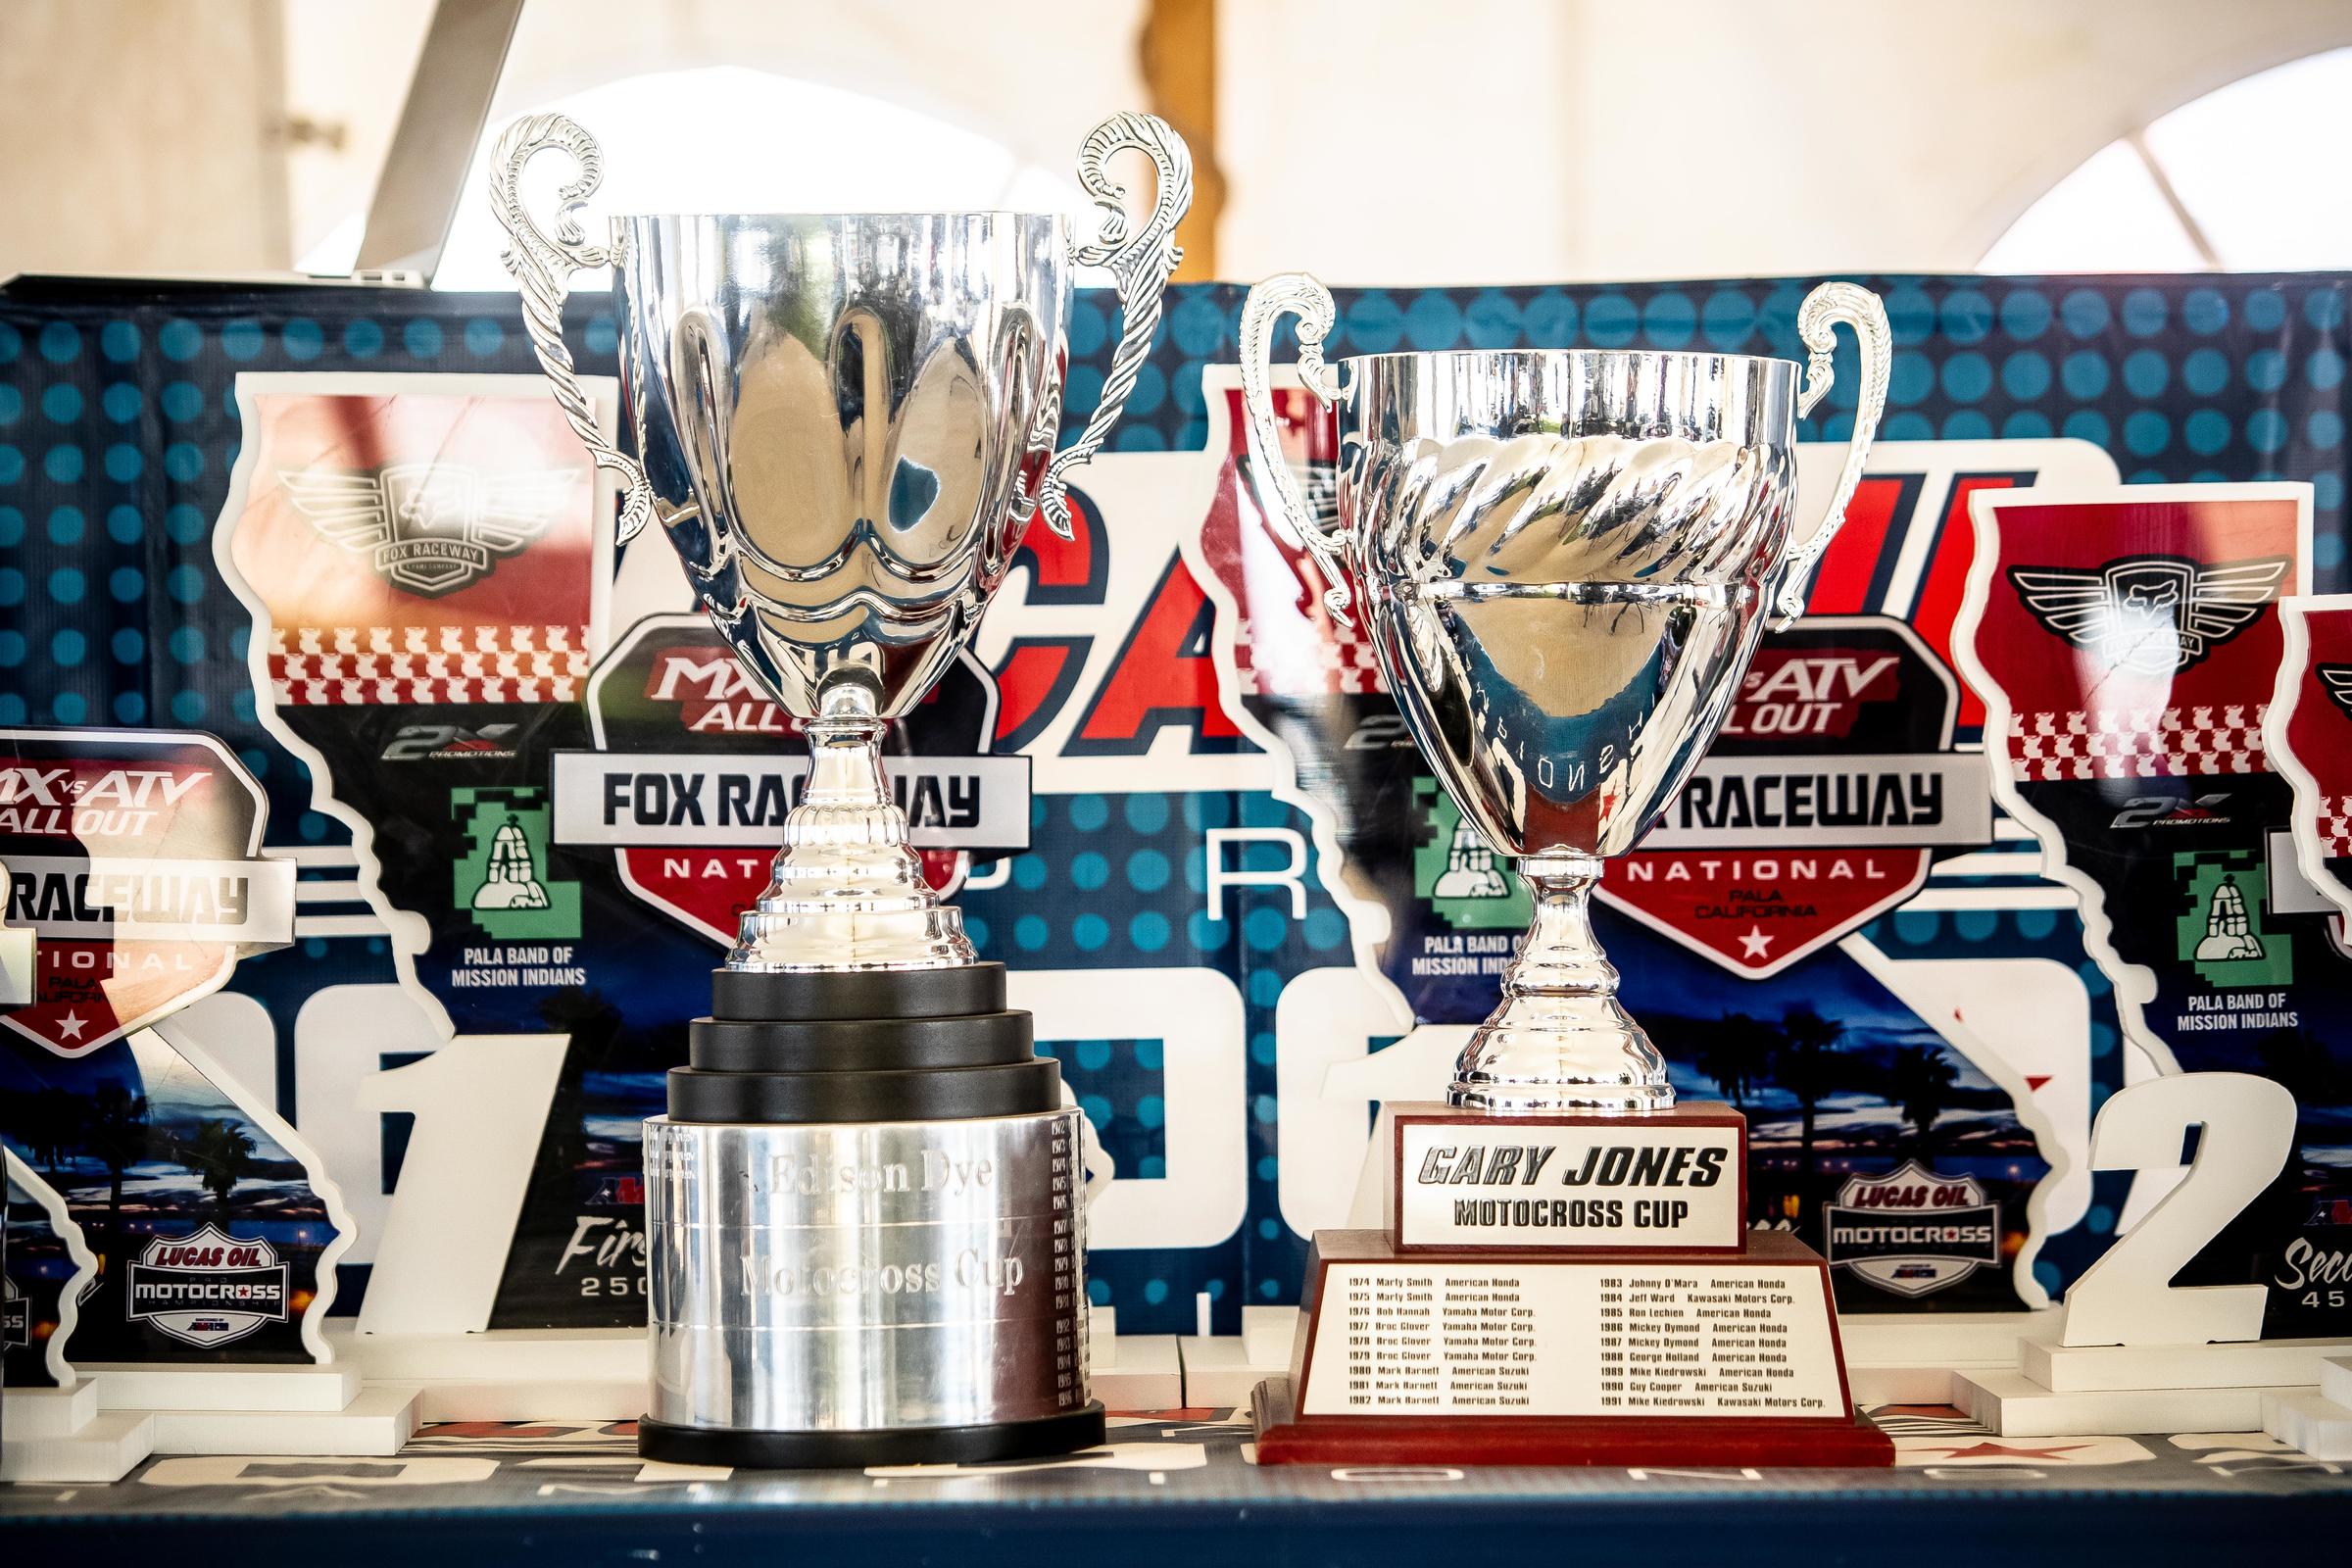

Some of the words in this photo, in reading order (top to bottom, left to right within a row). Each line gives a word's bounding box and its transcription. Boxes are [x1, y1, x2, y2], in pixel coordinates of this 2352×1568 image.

[383, 545, 408, 564] FOX
[413, 542, 478, 562] RACEWAY
[1746, 657, 1899, 702] ATV
[689, 703, 783, 731] ALL
[1751, 704, 1841, 734] OUT
[71, 770, 213, 808] ATV
[604, 772, 705, 826] FOX
[717, 772, 980, 827] RAAY
[1681, 772, 1943, 829] RACEWAY
[73, 809, 160, 836] OUT
[1627, 858, 1886, 882] NATIONAL
[4, 871, 248, 925] RACEWAY
[1729, 889, 1784, 903] PALA
[1695, 905, 1817, 920] CALIFORNIA
[1424, 936, 1463, 954] PALA
[1467, 935, 1508, 954] BAND
[464, 948, 504, 965] PALA
[507, 947, 548, 964] BAND
[552, 946, 573, 964] OF
[1412, 956, 1479, 975] MISSION
[452, 968, 518, 987] MISSION
[522, 967, 586, 986] INDIANS
[2187, 995, 2224, 1011] PALA
[2227, 994, 2264, 1010] BAND
[2268, 993, 2286, 1008] OF
[2178, 1013, 2237, 1031] MISSION
[2241, 1011, 2299, 1029] INDIANS
[770, 1151, 909, 1195] Edison
[920, 1149, 994, 1196] Dye
[1418, 1145, 1557, 1186] GARY
[1561, 1146, 1729, 1188] JONES
[359, 1033, 571, 1334] 1
[1853, 1185, 1929, 1207] LUCAS
[1932, 1185, 1971, 1206] OIL
[1454, 1198, 1623, 1228] MOTOCROSS
[1633, 1199, 1689, 1229] CUP
[2059, 1071, 2298, 1348] 2
[1834, 1226, 1992, 1245] MOTOCROSS
[155, 1247, 224, 1267] LUCAS
[226, 1247, 262, 1267] OIL
[740, 1253, 943, 1298] Motocross
[956, 1248, 1024, 1297] Cup
[134, 1284, 281, 1300] MOTOCROSS
[1348, 1277, 1370, 1287] 1974
[1375, 1277, 1403, 1289] Marty
[1405, 1277, 1433, 1287] Smith
[1444, 1277, 1490, 1288] American
[1491, 1278, 1520, 1288] Honda
[1598, 1278, 1623, 1289] 1983
[1627, 1278, 1662, 1291] Johnny
[1663, 1278, 1698, 1289] O'Mara
[1709, 1278, 1755, 1290] American
[1756, 1278, 1786, 1290] Honda
[1348, 1292, 1370, 1301] 1975
[1375, 1292, 1403, 1303] Marty
[1405, 1292, 1433, 1301] Smith
[1444, 1292, 1490, 1302] American
[1491, 1293, 1520, 1302] Honda
[1598, 1293, 1623, 1303] 1984
[1627, 1293, 1647, 1303] Jeff
[1648, 1293, 1676, 1304] Ward
[1686, 1293, 1732, 1304] Kawasaki
[1733, 1293, 1768, 1304] Motors
[1769, 1294, 1795, 1306] Corp.
[1348, 1306, 1370, 1316] 1976
[1375, 1306, 1394, 1316] Bob
[1395, 1306, 1431, 1316] Hannah
[1441, 1306, 1478, 1317] Yamaha
[1479, 1306, 1508, 1317] Motor
[1509, 1306, 1536, 1319] Corp.
[1599, 1307, 1623, 1318] 1985
[1628, 1307, 1646, 1318] Ron
[1647, 1307, 1685, 1319] Lechien
[1694, 1307, 1740, 1318] American
[1741, 1307, 1772, 1319] Honda
[1348, 1321, 1369, 1332] 1977
[1374, 1321, 1397, 1331] Broc
[1398, 1321, 1431, 1331] Glover
[1441, 1321, 1478, 1332] Yamaha
[1479, 1321, 1508, 1332] Motor
[1509, 1321, 1536, 1334] Corp.
[1599, 1322, 1624, 1333] 1986
[1628, 1322, 1662, 1334] Mickey
[1663, 1322, 1700, 1335] Dymond
[1711, 1322, 1757, 1334] American
[1758, 1322, 1788, 1334] Honda
[1348, 1336, 1371, 1347] 1978
[1375, 1336, 1398, 1346] Broc
[1400, 1336, 1432, 1347] Glover
[1442, 1336, 1479, 1347] Yamaha
[1480, 1336, 1509, 1347] Motor
[1510, 1336, 1537, 1348] Corp.
[1599, 1337, 1622, 1348] 1987
[1627, 1337, 1661, 1349] Mickey
[1662, 1337, 1699, 1349] Dymond
[1710, 1337, 1756, 1348] American
[1757, 1337, 1788, 1348] Honda
[1348, 1350, 1371, 1361] 1979
[1375, 1350, 1398, 1360] Broc
[1400, 1350, 1432, 1361] Glover
[1443, 1351, 1479, 1361] Yamaha
[1480, 1350, 1509, 1361] Motor
[1511, 1351, 1538, 1363] Corp.
[1599, 1351, 1624, 1362] 1988
[1628, 1351, 1663, 1364] George
[1664, 1351, 1700, 1363] Holland
[1710, 1351, 1756, 1363] American
[1757, 1352, 1788, 1363] Honda
[1348, 1365, 1372, 1376] 1980
[1376, 1365, 1401, 1376] Mark
[1450, 1365, 1496, 1376] American
[1497, 1365, 1530, 1377] Suzuki
[1599, 1366, 1624, 1377] 1989
[1628, 1366, 1652, 1377] Mike
[1653, 1366, 1707, 1378] Kiedrowski
[1717, 1366, 1763, 1378] American
[1764, 1366, 1794, 1378] Honda
[1348, 1380, 1370, 1391] 1981
[1374, 1380, 1400, 1390] Mark
[1448, 1381, 1494, 1391] American
[1495, 1381, 1528, 1392] Suzuki
[1599, 1381, 1624, 1392] 1990
[1628, 1381, 1647, 1394] Guy
[1648, 1382, 1683, 1394] Cooper
[1693, 1382, 1740, 1393] American
[1740, 1382, 1773, 1393] Suzuki
[1348, 1395, 1372, 1405] 1982
[1376, 1396, 1401, 1404] Mark
[1450, 1396, 1496, 1405] American
[1497, 1396, 1530, 1406] Suzuki
[1599, 1396, 1622, 1406] 1991
[1627, 1396, 1650, 1407] Mike
[1651, 1396, 1705, 1408] Kiedrowski
[1716, 1396, 1762, 1408] Kawasaki
[1763, 1397, 1798, 1409] Motors
[1799, 1396, 1826, 1409] Corp.
